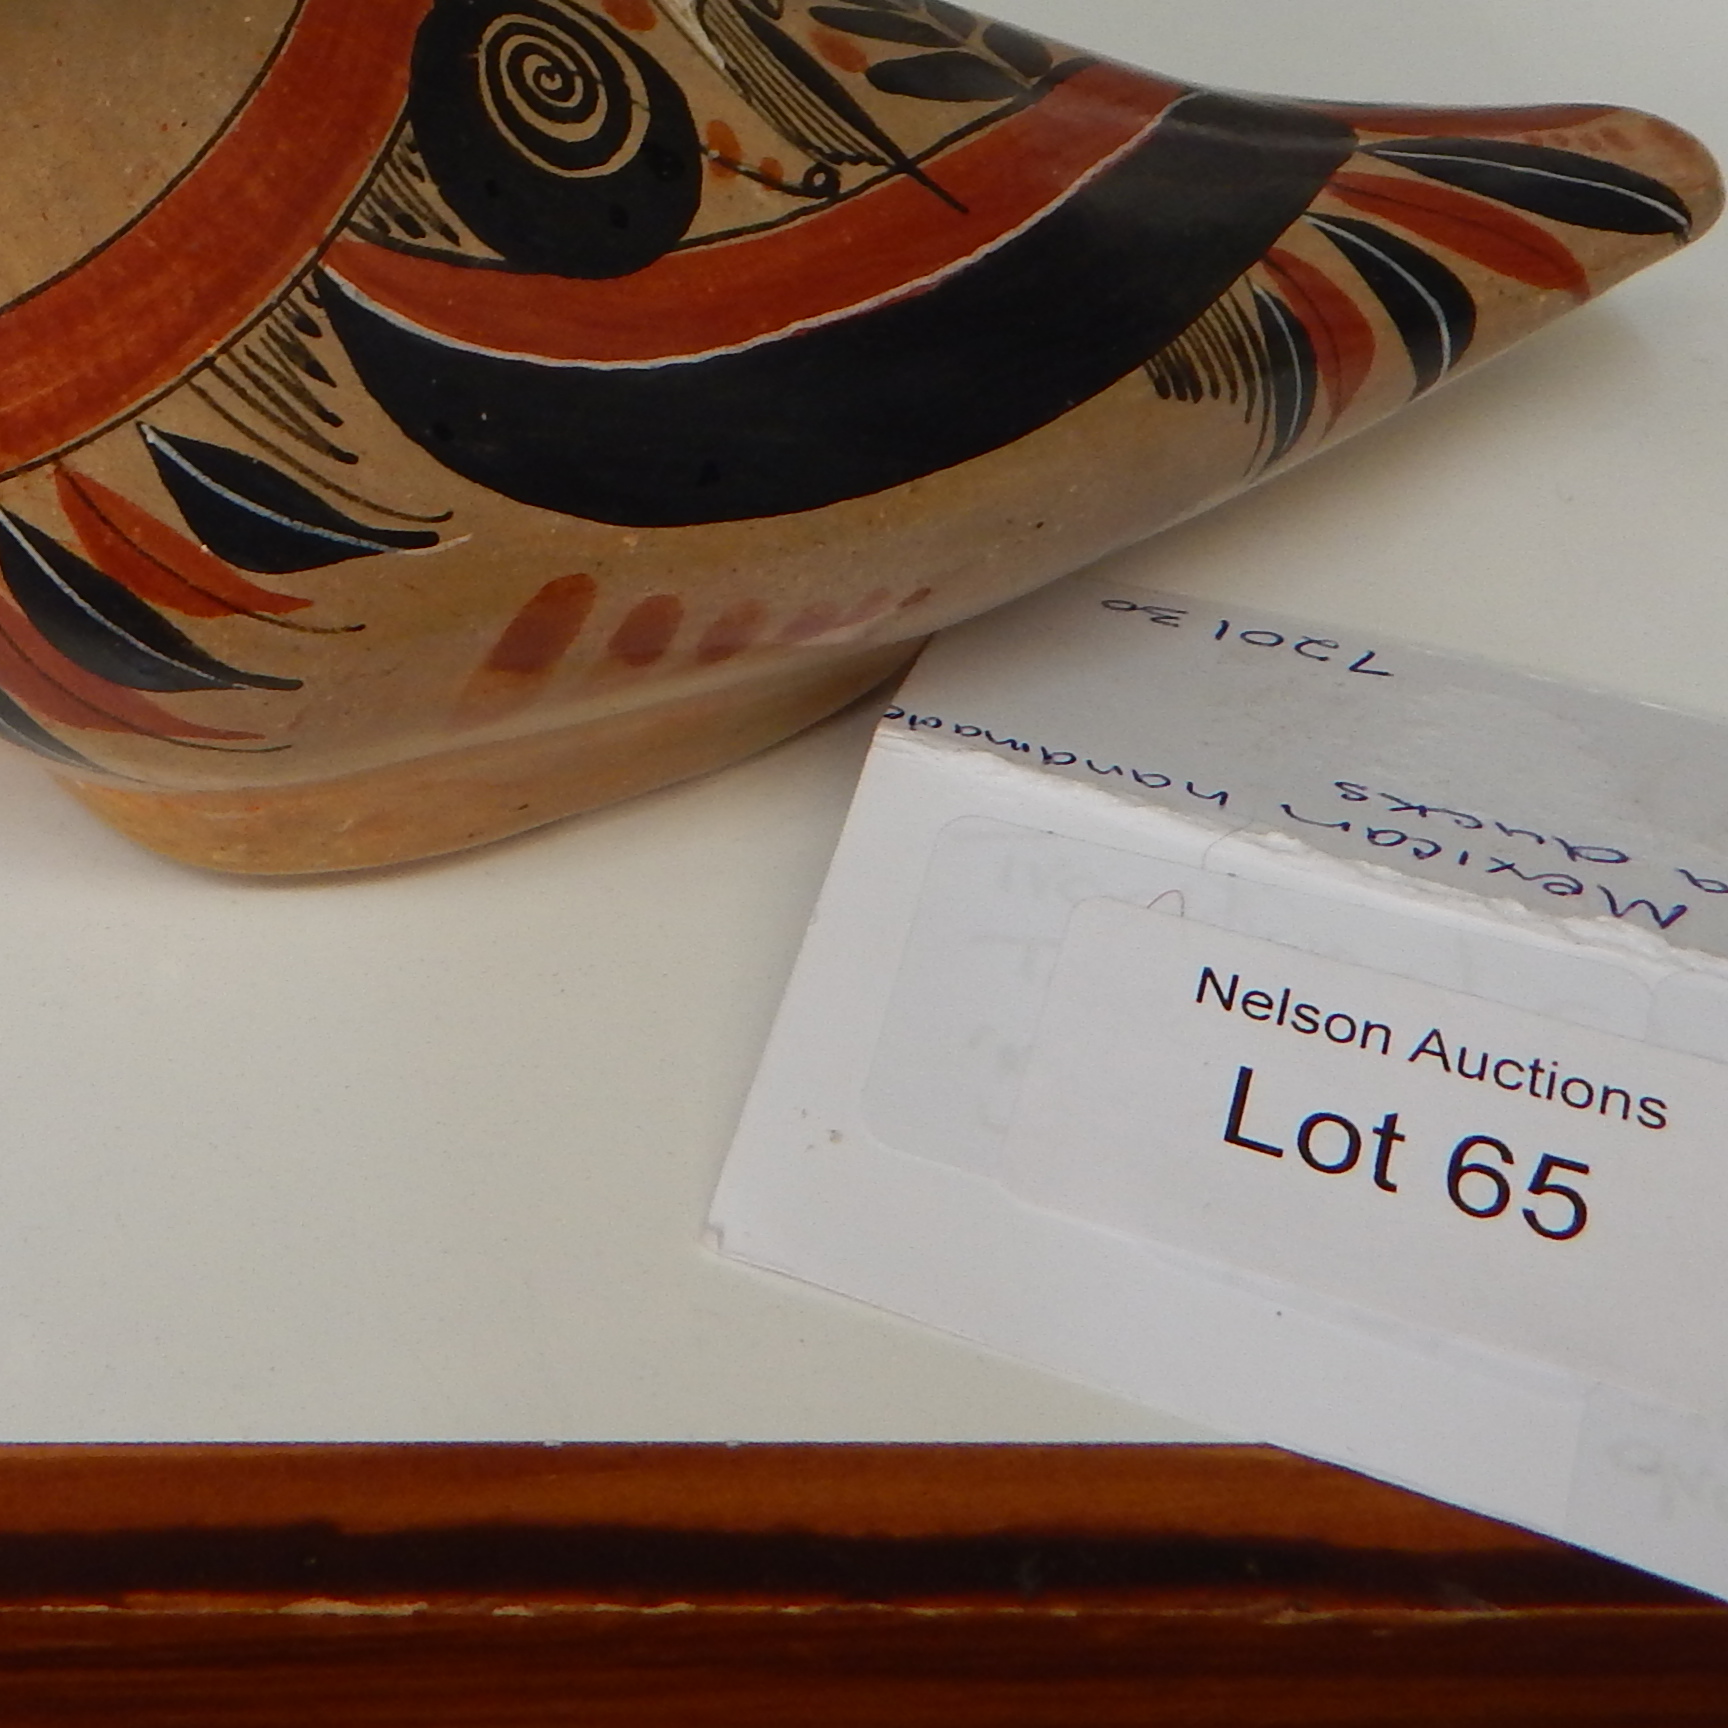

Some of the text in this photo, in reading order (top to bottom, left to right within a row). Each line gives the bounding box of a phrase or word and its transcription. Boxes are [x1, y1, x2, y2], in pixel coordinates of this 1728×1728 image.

[1280, 803, 1689, 930] Mexican
[1333, 780, 1630, 865] ducks
[1196, 966, 1668, 1130] Nelson Auctions
[1223, 1065, 1590, 1241] Lot 65
